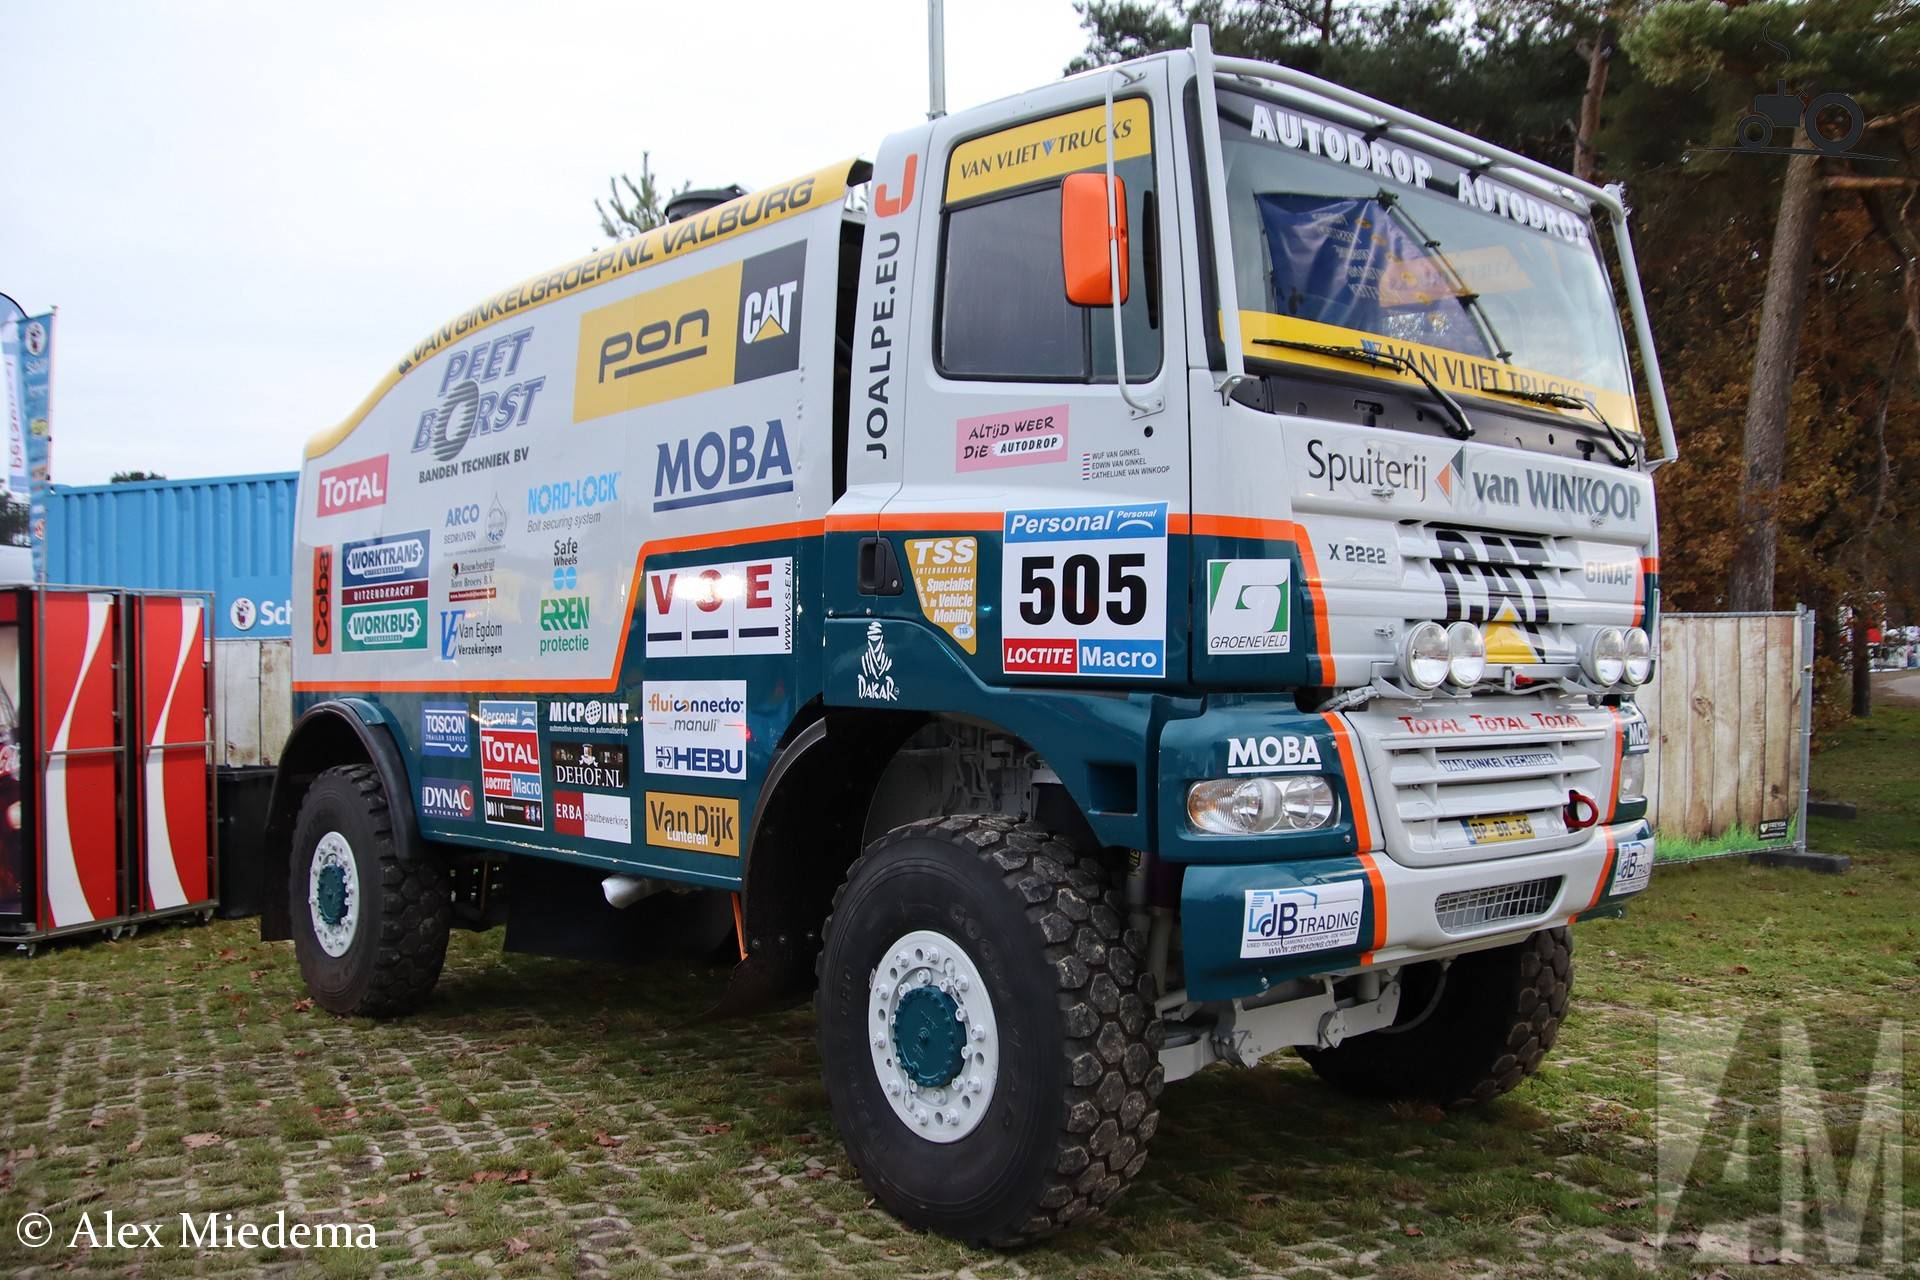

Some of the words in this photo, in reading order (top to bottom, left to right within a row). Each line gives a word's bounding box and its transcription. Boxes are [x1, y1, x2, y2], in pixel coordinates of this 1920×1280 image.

[960, 156, 992, 179] VAN
[997, 143, 1041, 168] VLIET
[1058, 119, 1133, 153] TRUCKS
[1250, 104, 1433, 189] AUTODROP
[1457, 172, 1590, 247] AUTODROP
[663, 177, 816, 255] VALBURG
[742, 280, 797, 344] CAT
[598, 308, 710, 384] pon
[866, 231, 901, 460] JOALPE.EU
[437, 326, 535, 397] PEET
[1387, 344, 1437, 382] VAN
[1443, 356, 1500, 391] VLIET
[411, 376, 546, 462] BORST
[1014, 416, 1056, 433] WEER
[1000, 437, 1058, 454] AUTODROP
[1119, 448, 1141, 457] GINKEL
[419, 463, 458, 484] BANDEN
[461, 451, 510, 475] TECHNIEK
[513, 446, 530, 464] BV
[654, 419, 793, 498] MOBA
[1092, 462, 1111, 470] EDWIN
[1125, 458, 1147, 467] GINKEL
[1128, 468, 1140, 476] VAN
[1141, 465, 1170, 475] WINKOOP
[1307, 438, 1427, 502] Spuiterij
[1472, 470, 1520, 506] van
[1526, 469, 1641, 522] WINKOOP
[528, 471, 620, 516] NORD-LOCK
[445, 503, 480, 528] ARCO
[527, 520, 542, 534] Bolt
[542, 514, 572, 530] securing
[574, 511, 601, 529] system
[1010, 510, 1114, 535] Personal
[1117, 508, 1158, 519] Personal
[351, 543, 419, 570] WORKTRANS
[554, 537, 578, 555] Safe
[913, 539, 975, 565] TSS
[1328, 543, 1340, 561] X
[1345, 545, 1387, 564] 2222
[553, 555, 578, 566] Wheels
[916, 566, 971, 575] INTERNATIONAL
[1585, 561, 1634, 586] GINAF
[353, 585, 415, 601] UITZENDKRACHT
[926, 577, 973, 594] Specialist
[1019, 553, 1147, 626] 505
[930, 598, 937, 608] in
[939, 594, 973, 608] Vehicle
[353, 612, 415, 635] WORKBUS
[540, 597, 590, 631] ERREN
[933, 608, 974, 625] Mobility
[458, 622, 474, 638] Van
[476, 621, 503, 642] Egdom
[1210, 635, 1287, 649] GROENEVELD
[458, 643, 503, 657] Verzekeringen
[539, 634, 589, 656] protectie
[1006, 646, 1073, 665] LOCTITE
[1082, 645, 1158, 668] Macro
[858, 674, 898, 702] DAKAR
[549, 700, 629, 725] MICPOINT
[650, 693, 742, 713] fluiconnecto
[425, 715, 465, 734] TOSCON
[480, 708, 519, 727] Personal
[673, 717, 717, 733] manuli
[674, 747, 743, 774] HEBU
[1228, 736, 1321, 766] MOBA
[555, 765, 624, 788] DEHOF.NL
[1439, 758, 1468, 773] VAN
[1468, 757, 1504, 770] GINKEL
[485, 776, 511, 791] LOCTITE
[513, 777, 541, 796] Macro
[425, 786, 471, 811] DYNAC
[556, 803, 583, 821] ERBA
[584, 811, 629, 830] plaatbewerking
[650, 800, 689, 833] Van
[694, 804, 734, 847] Dijk
[666, 826, 709, 846] Lunteren
[1299, 910, 1360, 934] TRADING
